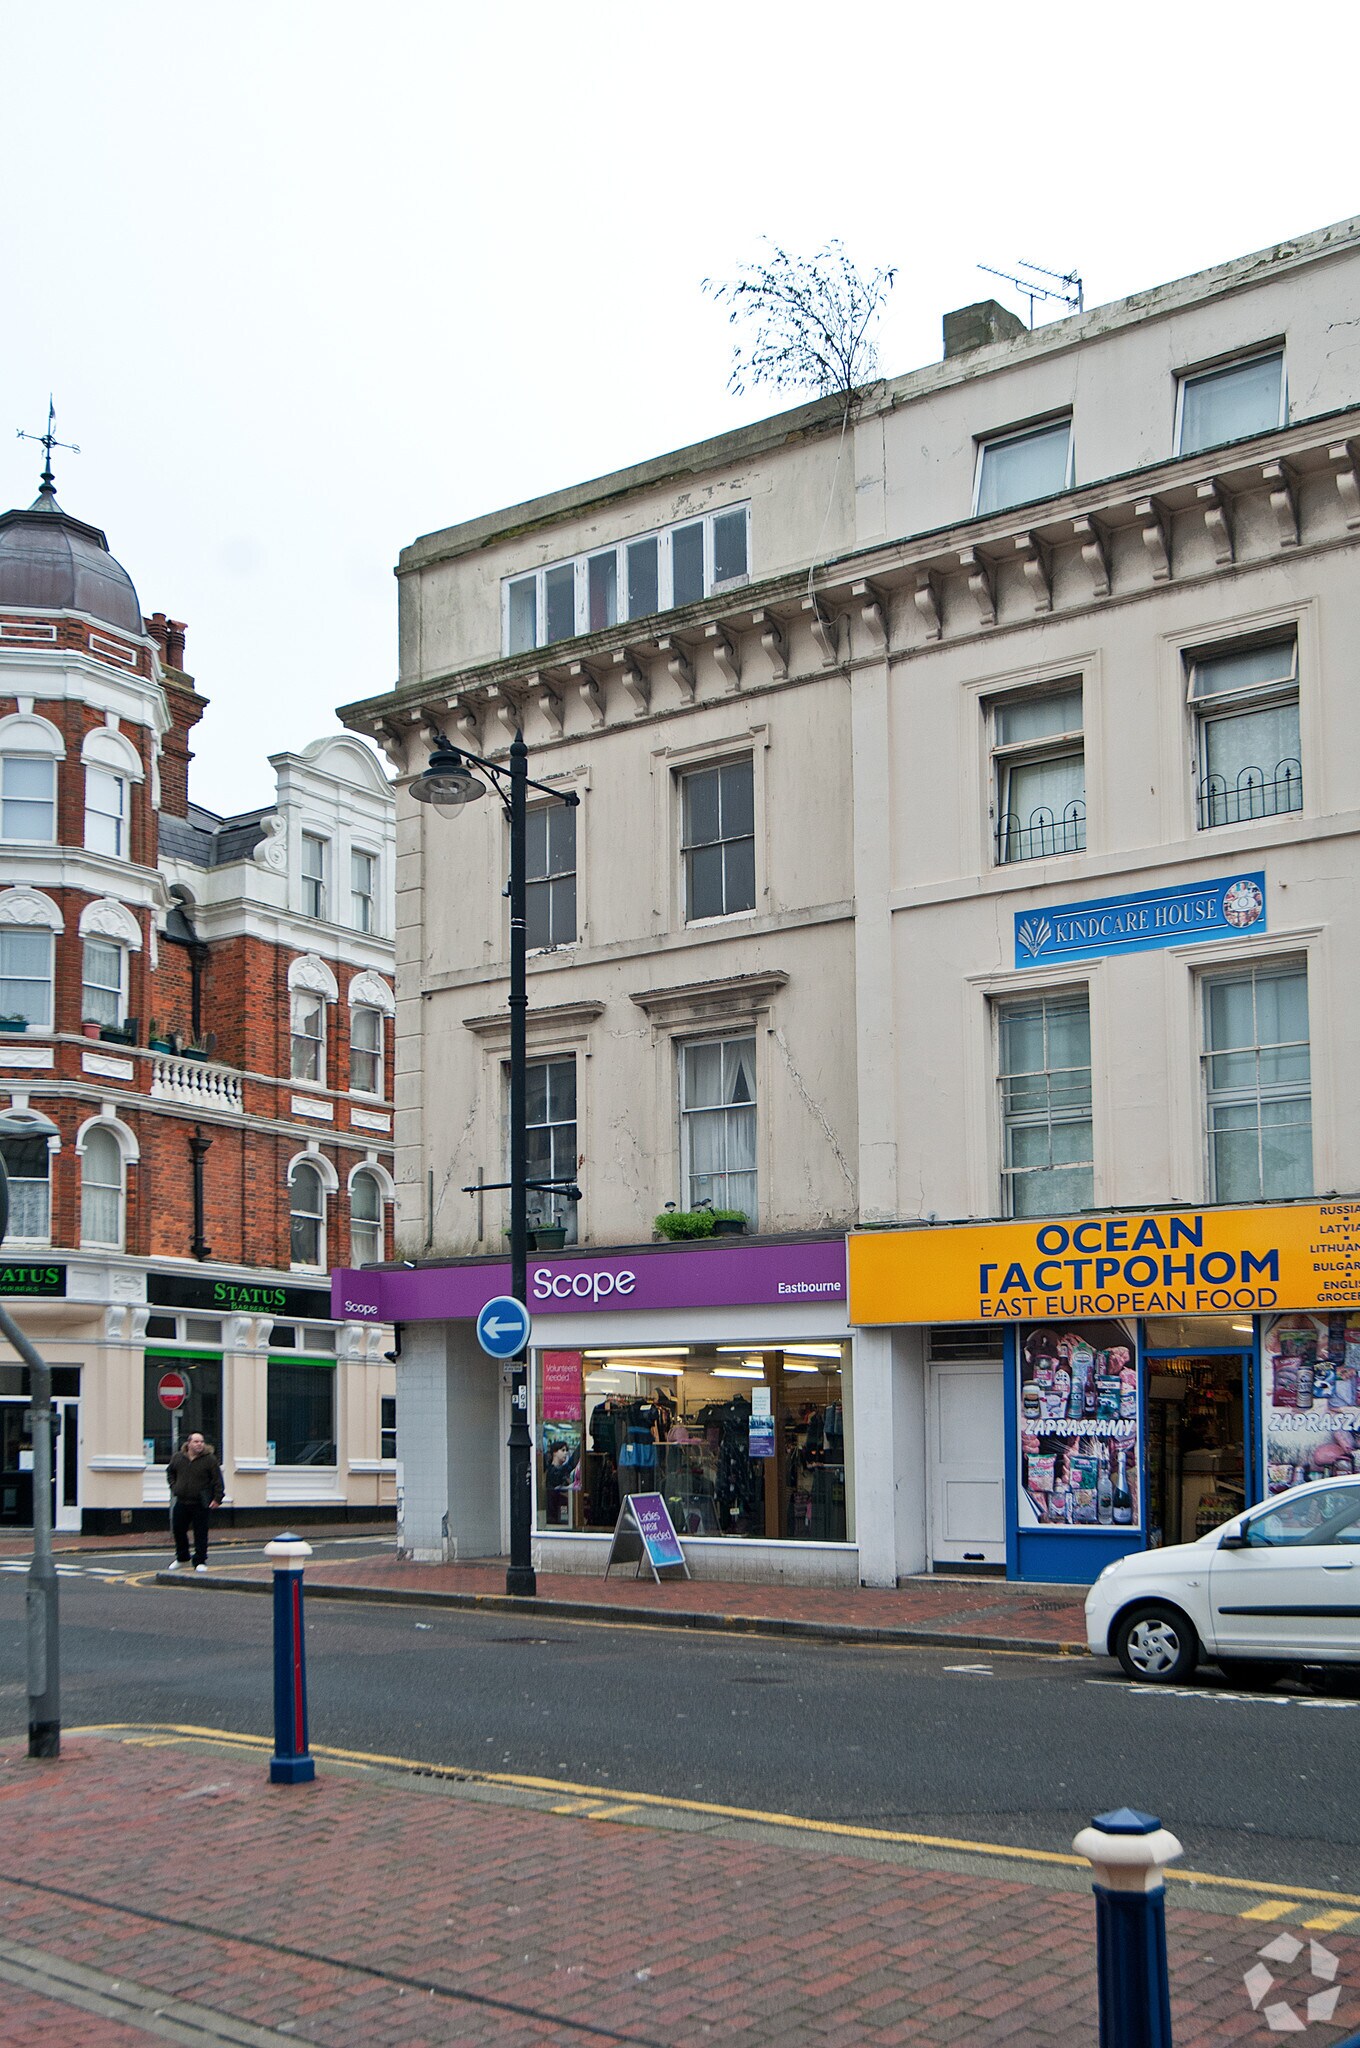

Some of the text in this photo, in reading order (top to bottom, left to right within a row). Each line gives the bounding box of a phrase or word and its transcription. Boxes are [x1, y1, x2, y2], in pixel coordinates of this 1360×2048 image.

[1055, 898, 1217, 943] KINDCARE HOUSE
[1036, 1215, 1203, 1256] OCEAN
[979, 1249, 1279, 1294] ГАСТРОНОМ
[1313, 1262, 1360, 1272] BULGAR
[0, 1268, 60, 1284] ATUS
[533, 1267, 636, 1303] Scope
[777, 1280, 842, 1294] Eastbourne
[213, 1282, 287, 1306] STATUS
[980, 1287, 1279, 1317] EAST EUROPEAN FOOD
[345, 1300, 379, 1316] Scope
[545, 1363, 578, 1373] Volunteers
[545, 1373, 570, 1382] needed
[1025, 1419, 1136, 1437] ZAPRASZAMY
[638, 1510, 661, 1522] Ladies
[642, 1521, 658, 1532] wear
[645, 1529, 672, 1541] needed
